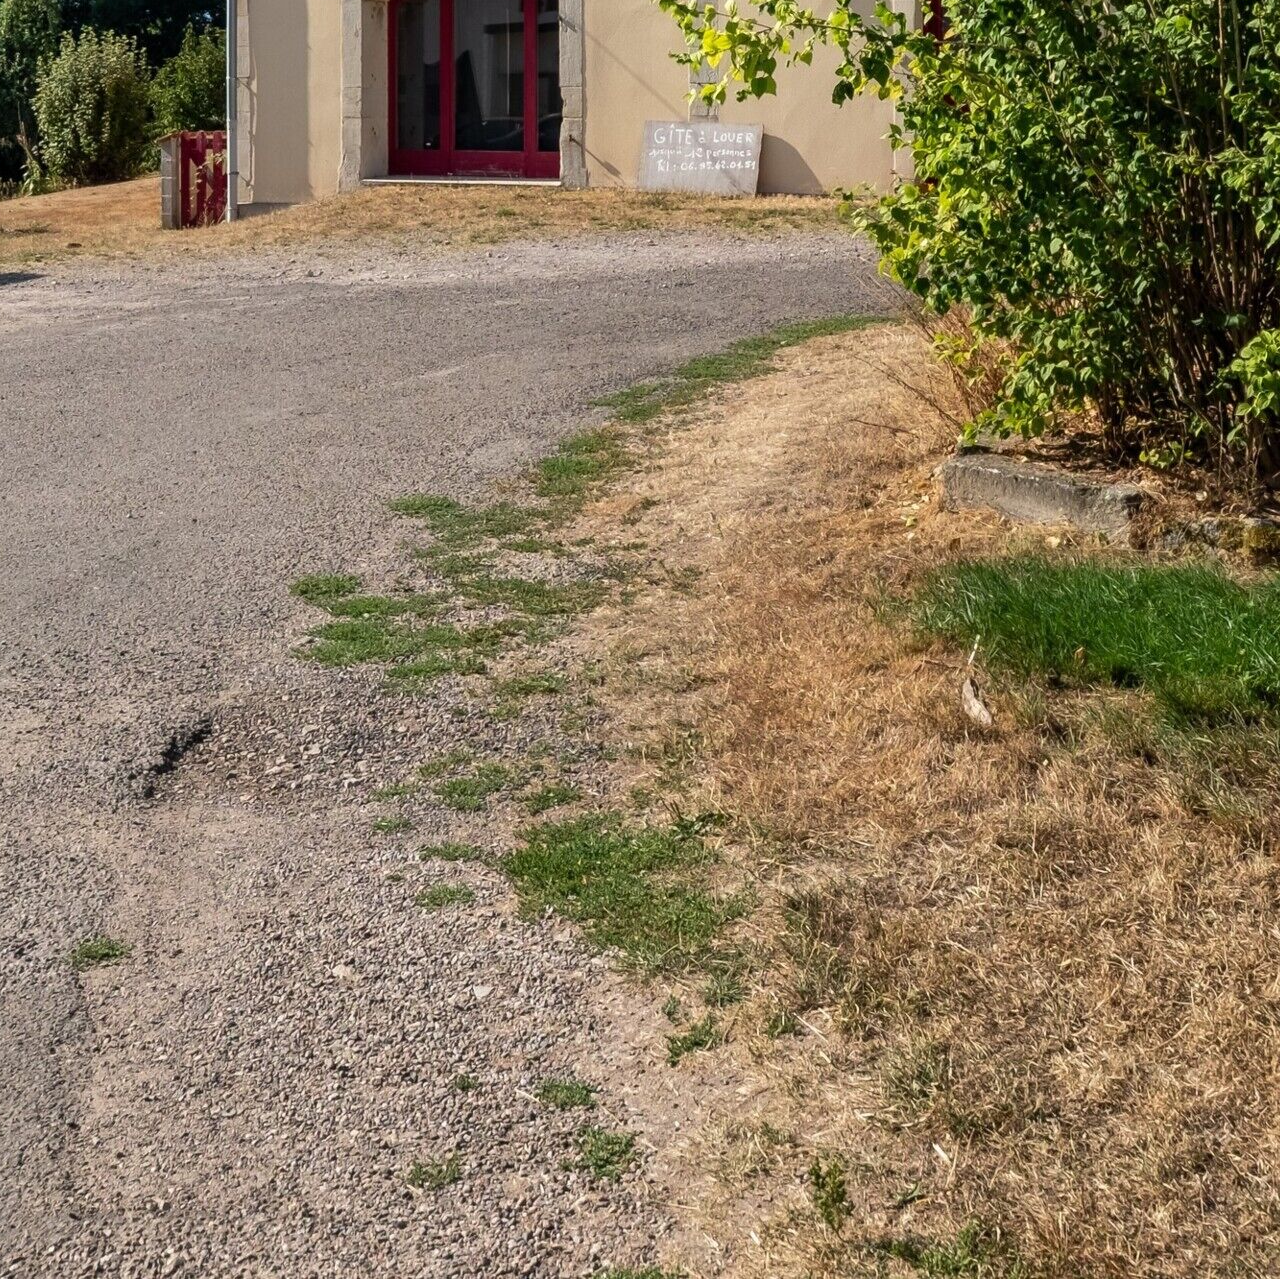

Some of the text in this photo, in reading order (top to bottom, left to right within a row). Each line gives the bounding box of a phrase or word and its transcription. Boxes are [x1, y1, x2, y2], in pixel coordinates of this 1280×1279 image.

[653, 123, 693, 145] GÎTE
[713, 131, 754, 144] LOUER
[684, 147, 703, 159] 12
[706, 148, 752, 159] personnes
